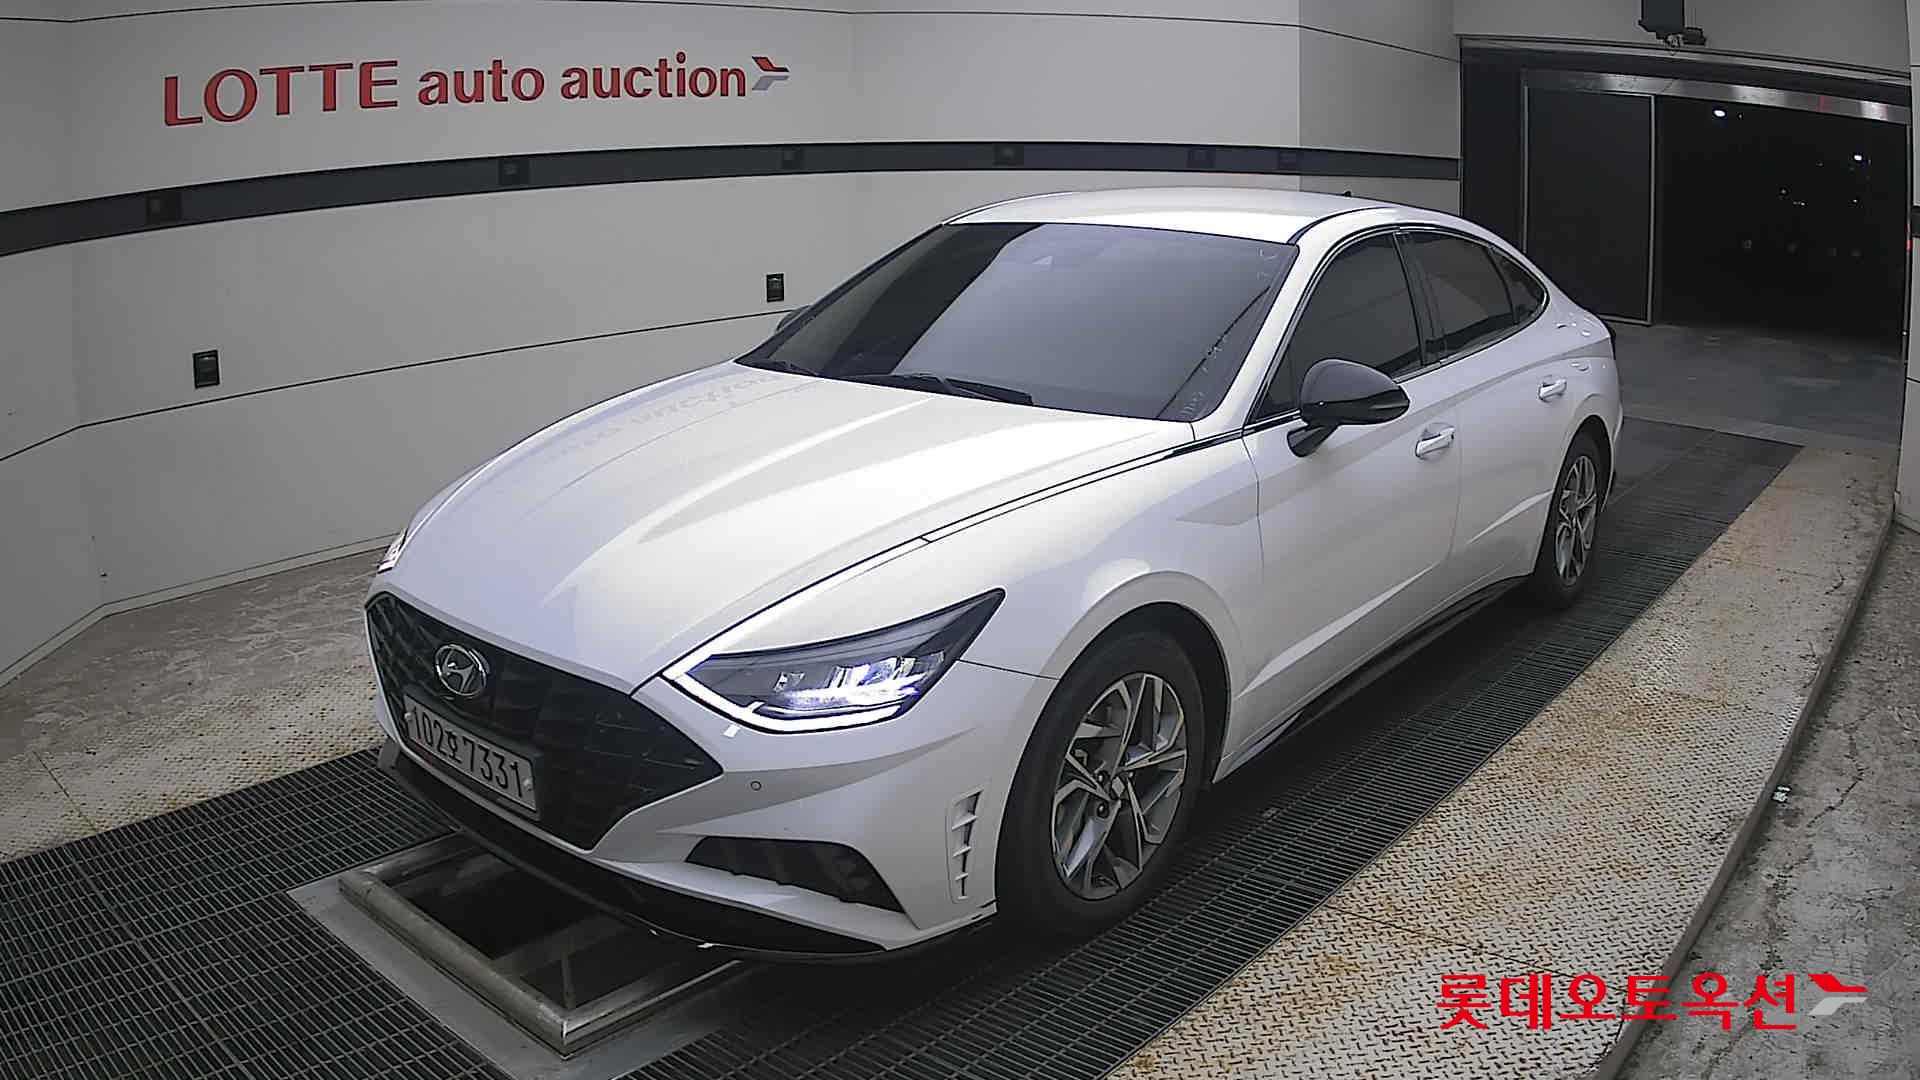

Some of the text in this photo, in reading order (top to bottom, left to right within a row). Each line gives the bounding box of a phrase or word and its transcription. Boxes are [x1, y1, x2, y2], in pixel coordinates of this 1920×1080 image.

[163, 51, 747, 127] LOTTE auto auction
